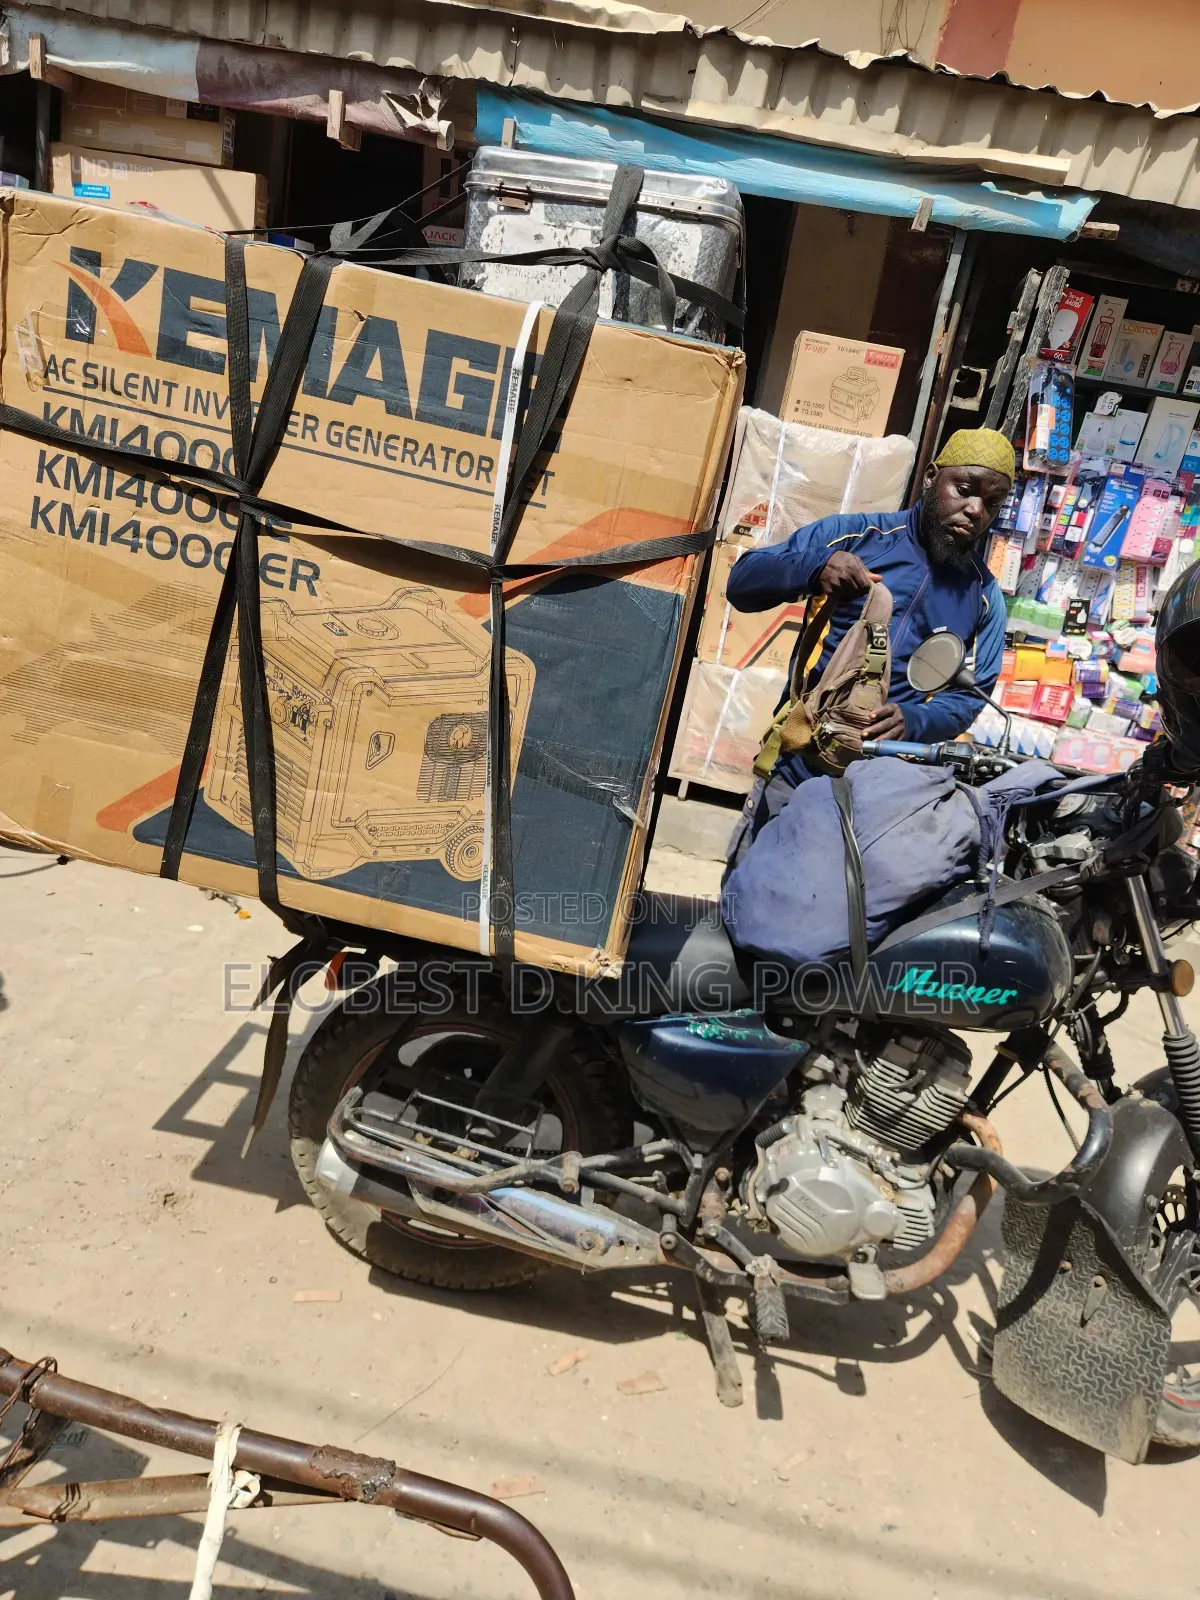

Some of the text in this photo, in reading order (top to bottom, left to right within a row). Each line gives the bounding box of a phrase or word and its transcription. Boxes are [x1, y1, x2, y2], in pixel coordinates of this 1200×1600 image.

[71, 155, 109, 178] UHD
[1122, 323, 1159, 336] LONTOR
[43, 353, 76, 385] AC
[82, 361, 180, 405] SILENT
[184, 386, 319, 443] INVER
[325, 419, 494, 485] GENERATOR
